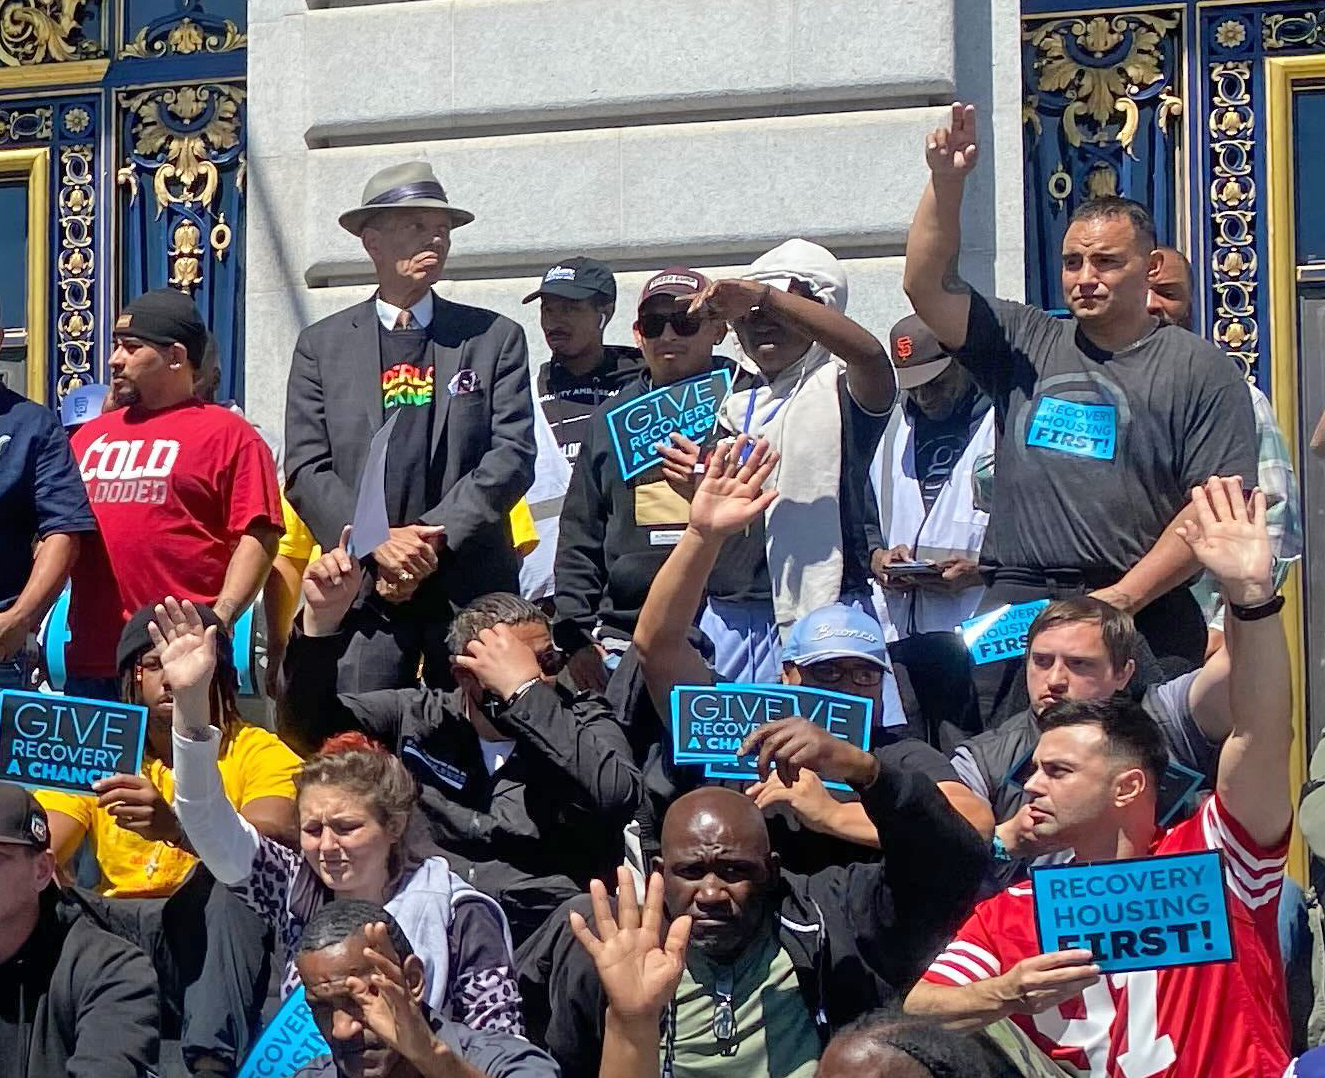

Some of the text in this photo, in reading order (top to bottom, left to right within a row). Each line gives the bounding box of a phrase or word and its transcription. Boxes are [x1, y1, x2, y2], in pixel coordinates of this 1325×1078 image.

[625, 378, 716, 433] GIVE
[1046, 403, 1112, 421] RECOVERY
[629, 399, 717, 451] RECOVERY
[632, 413, 716, 466] A CHNCE
[1040, 415, 1112, 437] HOUSING
[1035, 427, 1110, 454] FIRST!
[79, 433, 181, 482] COLD
[87, 479, 168, 505] LOODED
[978, 634, 1030, 658] FIRS
[690, 695, 783, 722] GIVE
[14, 702, 128, 750] GIVE
[691, 722, 761, 736] RECOVE
[12, 739, 124, 770] RECOVERY
[687, 737, 701, 750] A
[6, 759, 116, 785] A CHANCE
[1050, 865, 1207, 900] RECOVERY
[1054, 893, 1210, 929] HOUSING
[1057, 920, 1215, 962] FIRST!
